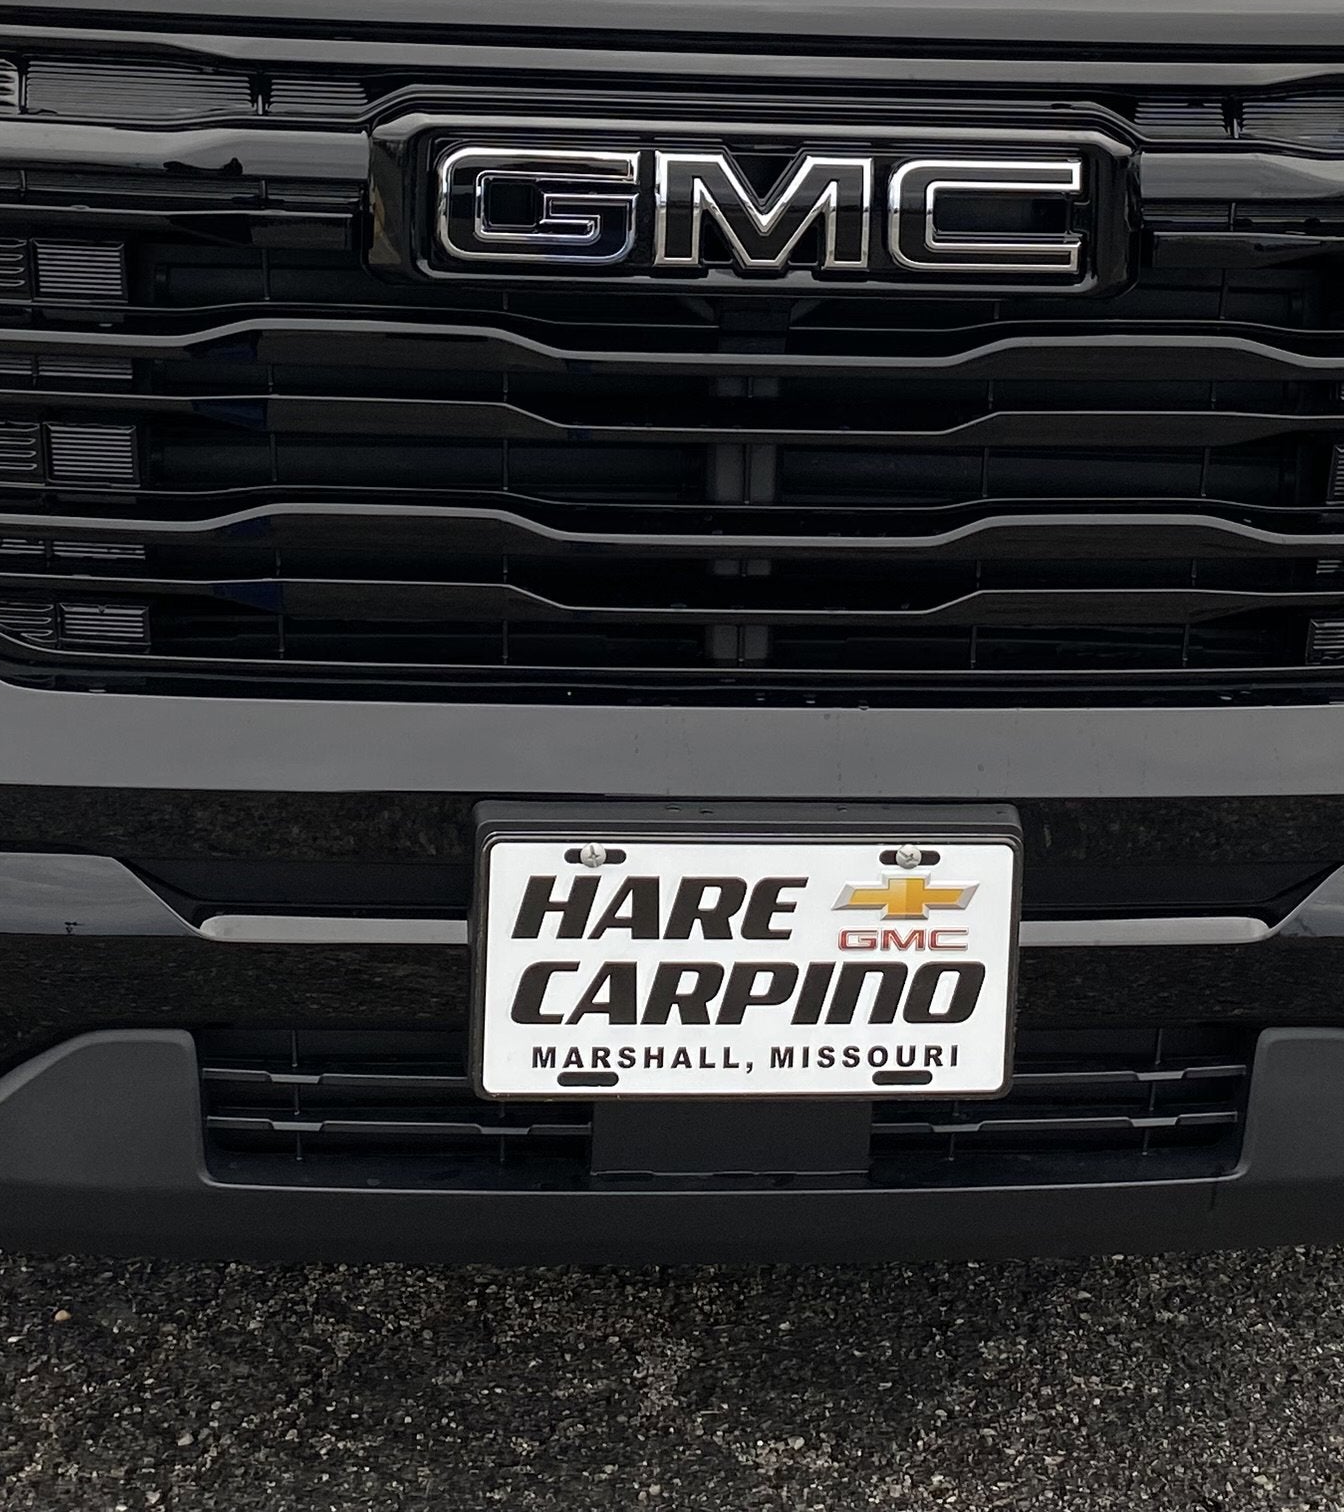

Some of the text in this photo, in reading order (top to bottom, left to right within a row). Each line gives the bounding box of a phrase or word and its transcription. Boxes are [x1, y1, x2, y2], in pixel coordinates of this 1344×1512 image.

[436, 146, 1082, 272] GMC
[511, 875, 808, 940] HARE
[837, 927, 968, 952] GMC
[510, 961, 986, 1026] CARPINO
[532, 1044, 958, 1074] MARSHALL, MISSOURI
